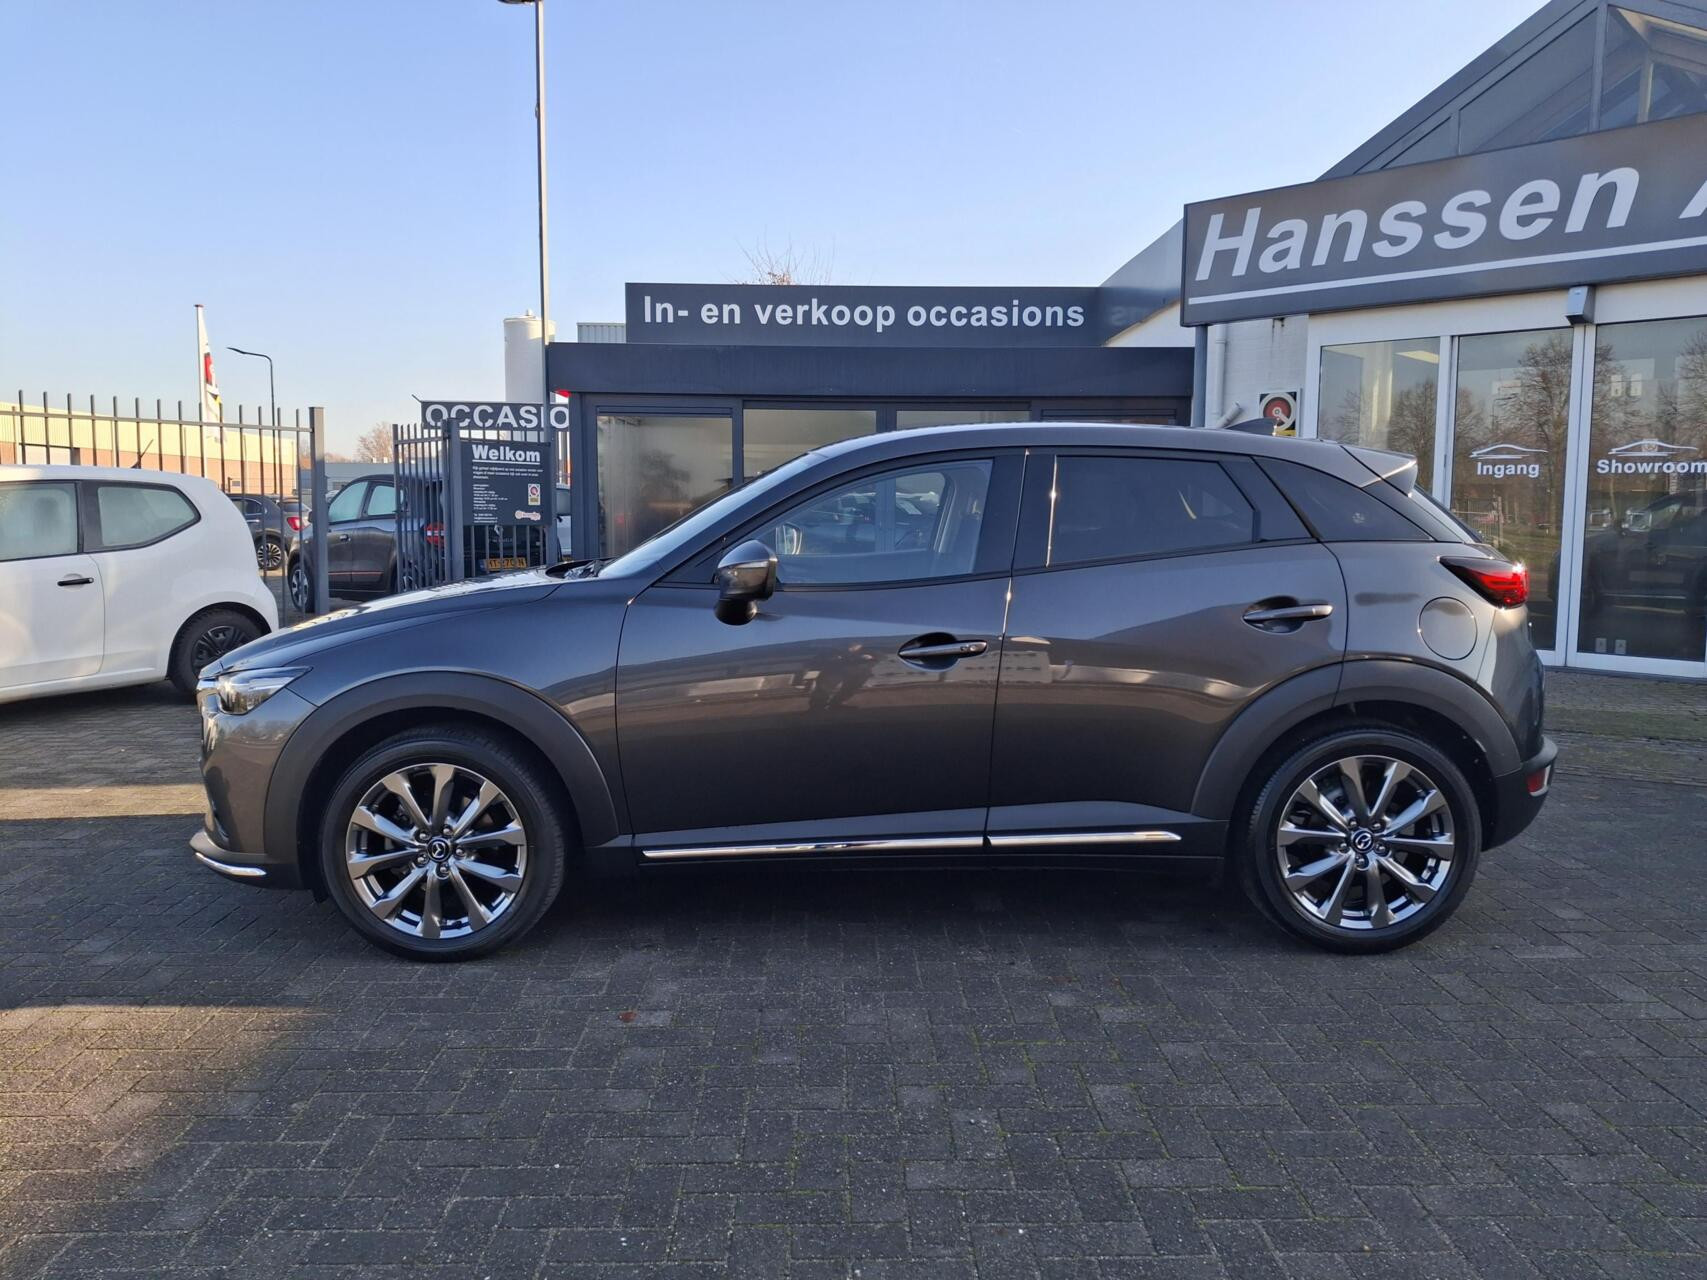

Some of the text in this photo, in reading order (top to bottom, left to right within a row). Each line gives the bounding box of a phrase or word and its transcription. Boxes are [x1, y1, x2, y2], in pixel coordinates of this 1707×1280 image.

[1194, 166, 1640, 282] Hanssen
[643, 296, 1086, 333] In- en verkoop occasions
[472, 444, 541, 462] Welkom
[1476, 461, 1540, 478] Ingang
[1596, 459, 1707, 474] Showroom
